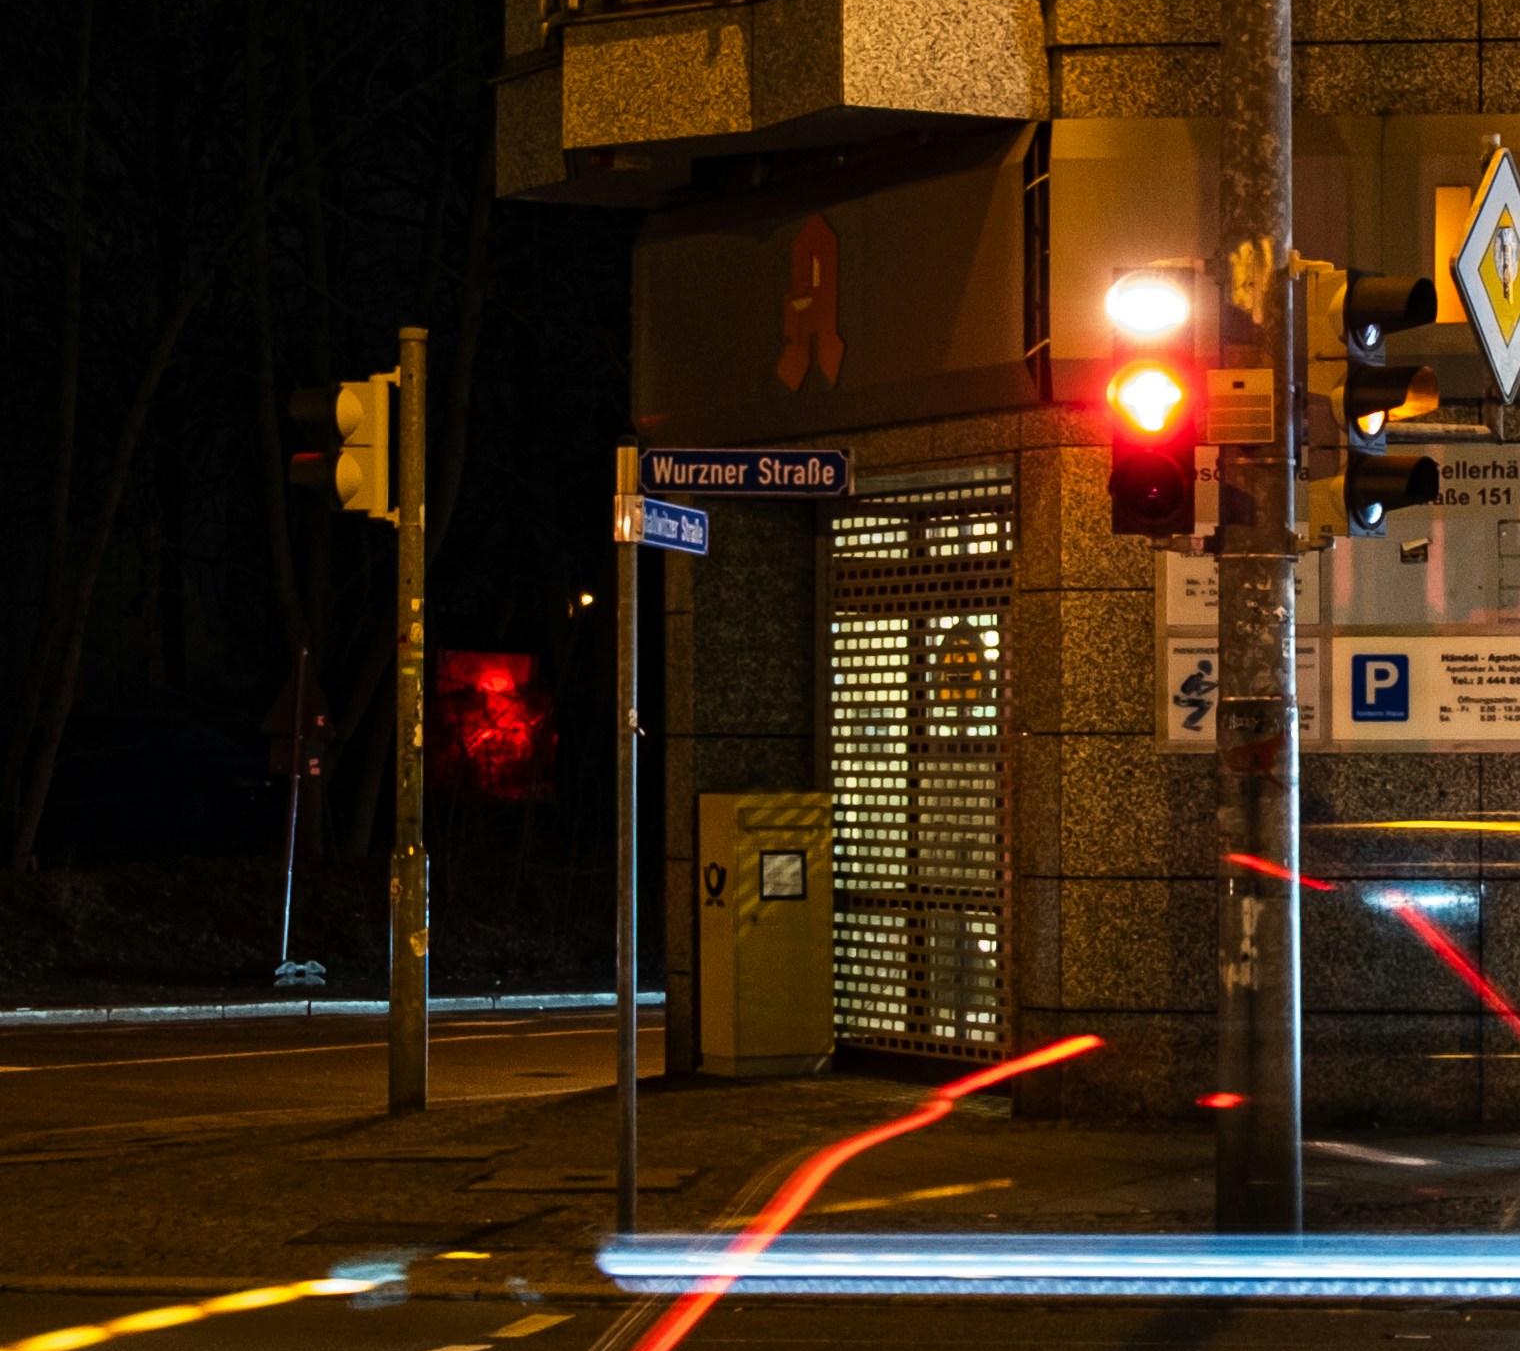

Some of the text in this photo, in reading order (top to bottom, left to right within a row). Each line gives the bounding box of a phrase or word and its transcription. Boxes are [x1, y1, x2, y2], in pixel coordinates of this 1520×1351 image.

[652, 456, 835, 486] Wurzner Straße
[1432, 487, 1512, 506] aße 151
[1366, 660, 1399, 705] P
